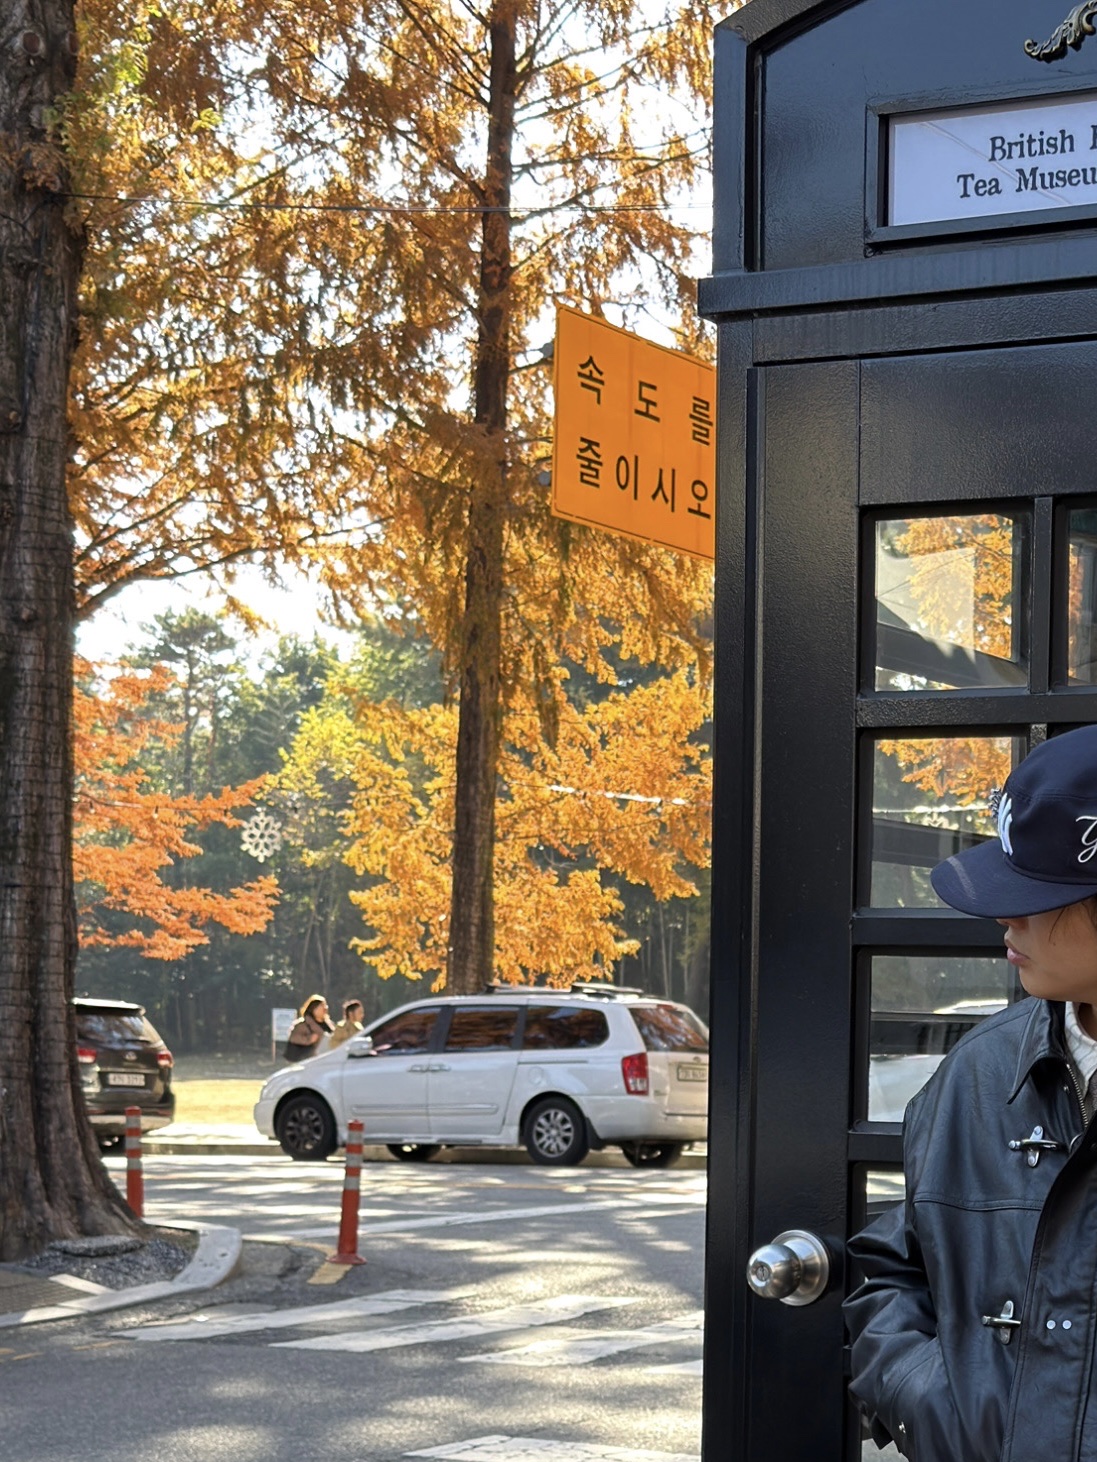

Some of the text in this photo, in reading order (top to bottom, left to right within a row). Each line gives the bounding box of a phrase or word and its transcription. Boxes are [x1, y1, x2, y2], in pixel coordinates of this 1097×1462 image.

[987, 129, 1075, 163] British
[956, 172, 1003, 199] Tea
[575, 436, 712, 520] 줄이시오
